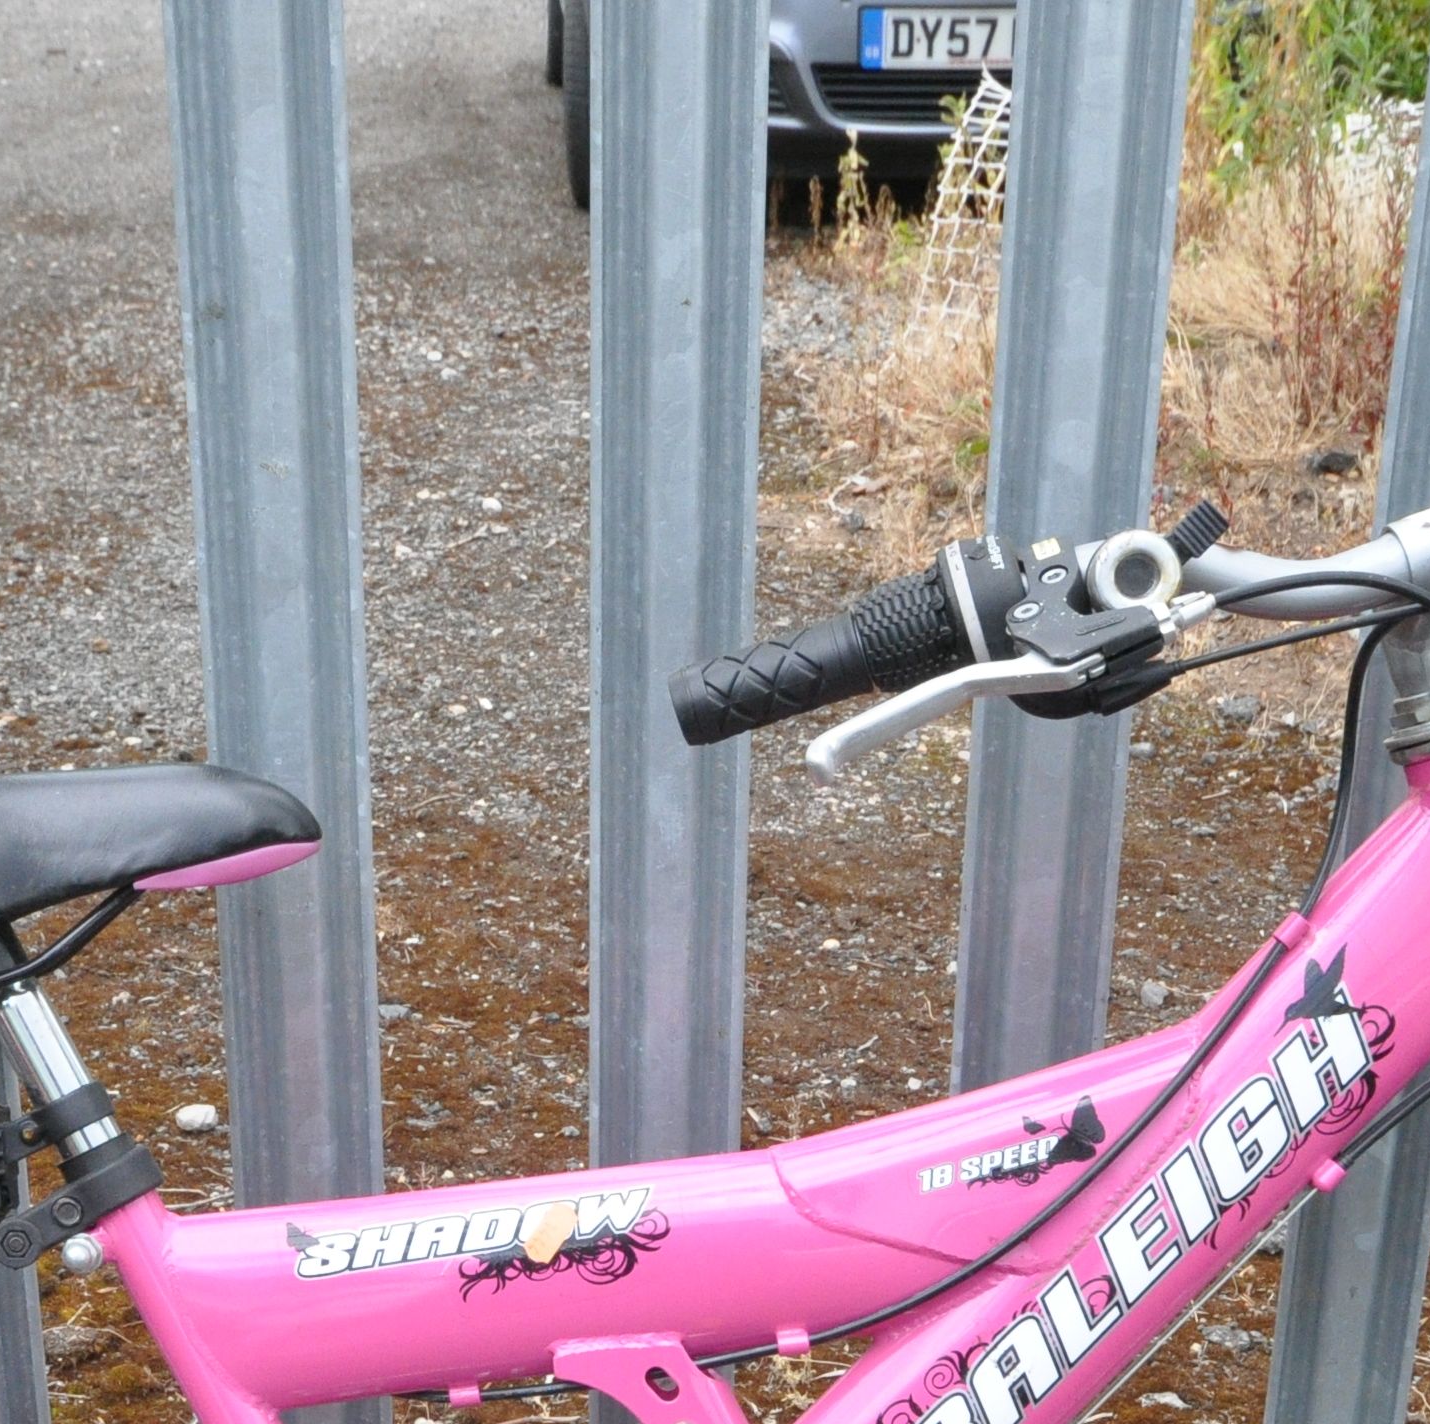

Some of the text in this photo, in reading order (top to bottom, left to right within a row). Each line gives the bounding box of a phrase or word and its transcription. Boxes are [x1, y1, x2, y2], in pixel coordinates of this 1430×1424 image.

[891, 18, 998, 58] DY57
[918, 1134, 1061, 1192] 18 SPEED
